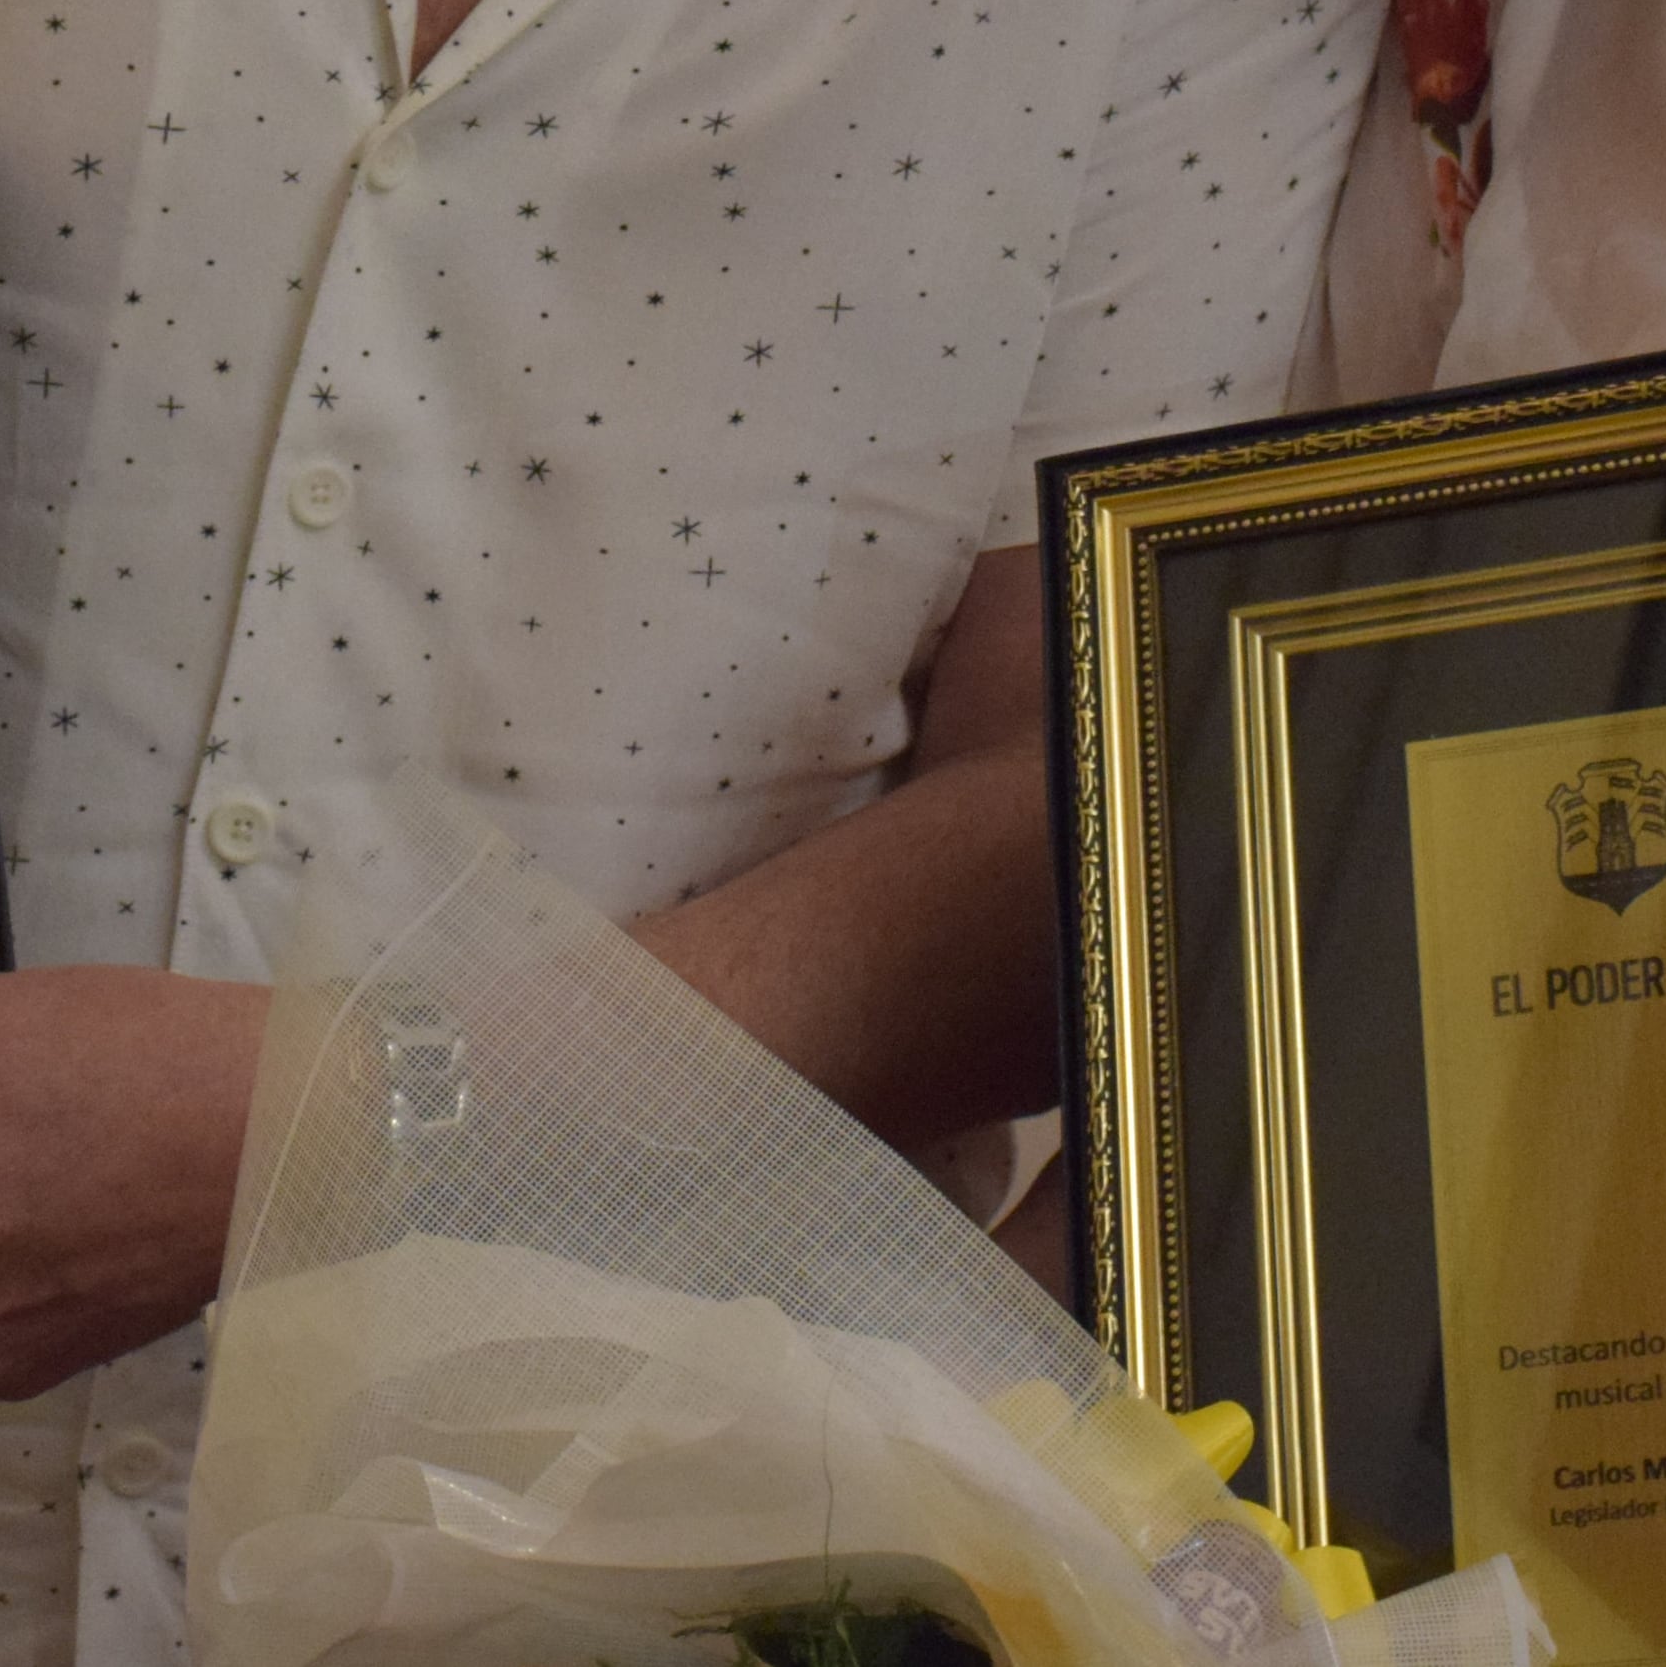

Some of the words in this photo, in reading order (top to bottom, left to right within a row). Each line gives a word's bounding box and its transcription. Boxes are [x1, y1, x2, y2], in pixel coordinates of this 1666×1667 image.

[1491, 972, 1533, 1017] EL
[1544, 954, 1665, 1010] PODER
[1497, 1328, 1666, 1371] Destacando
[1554, 1372, 1663, 1411] musical
[1552, 1459, 1635, 1490] Carlos
[1549, 1497, 1660, 1530] Legislador
